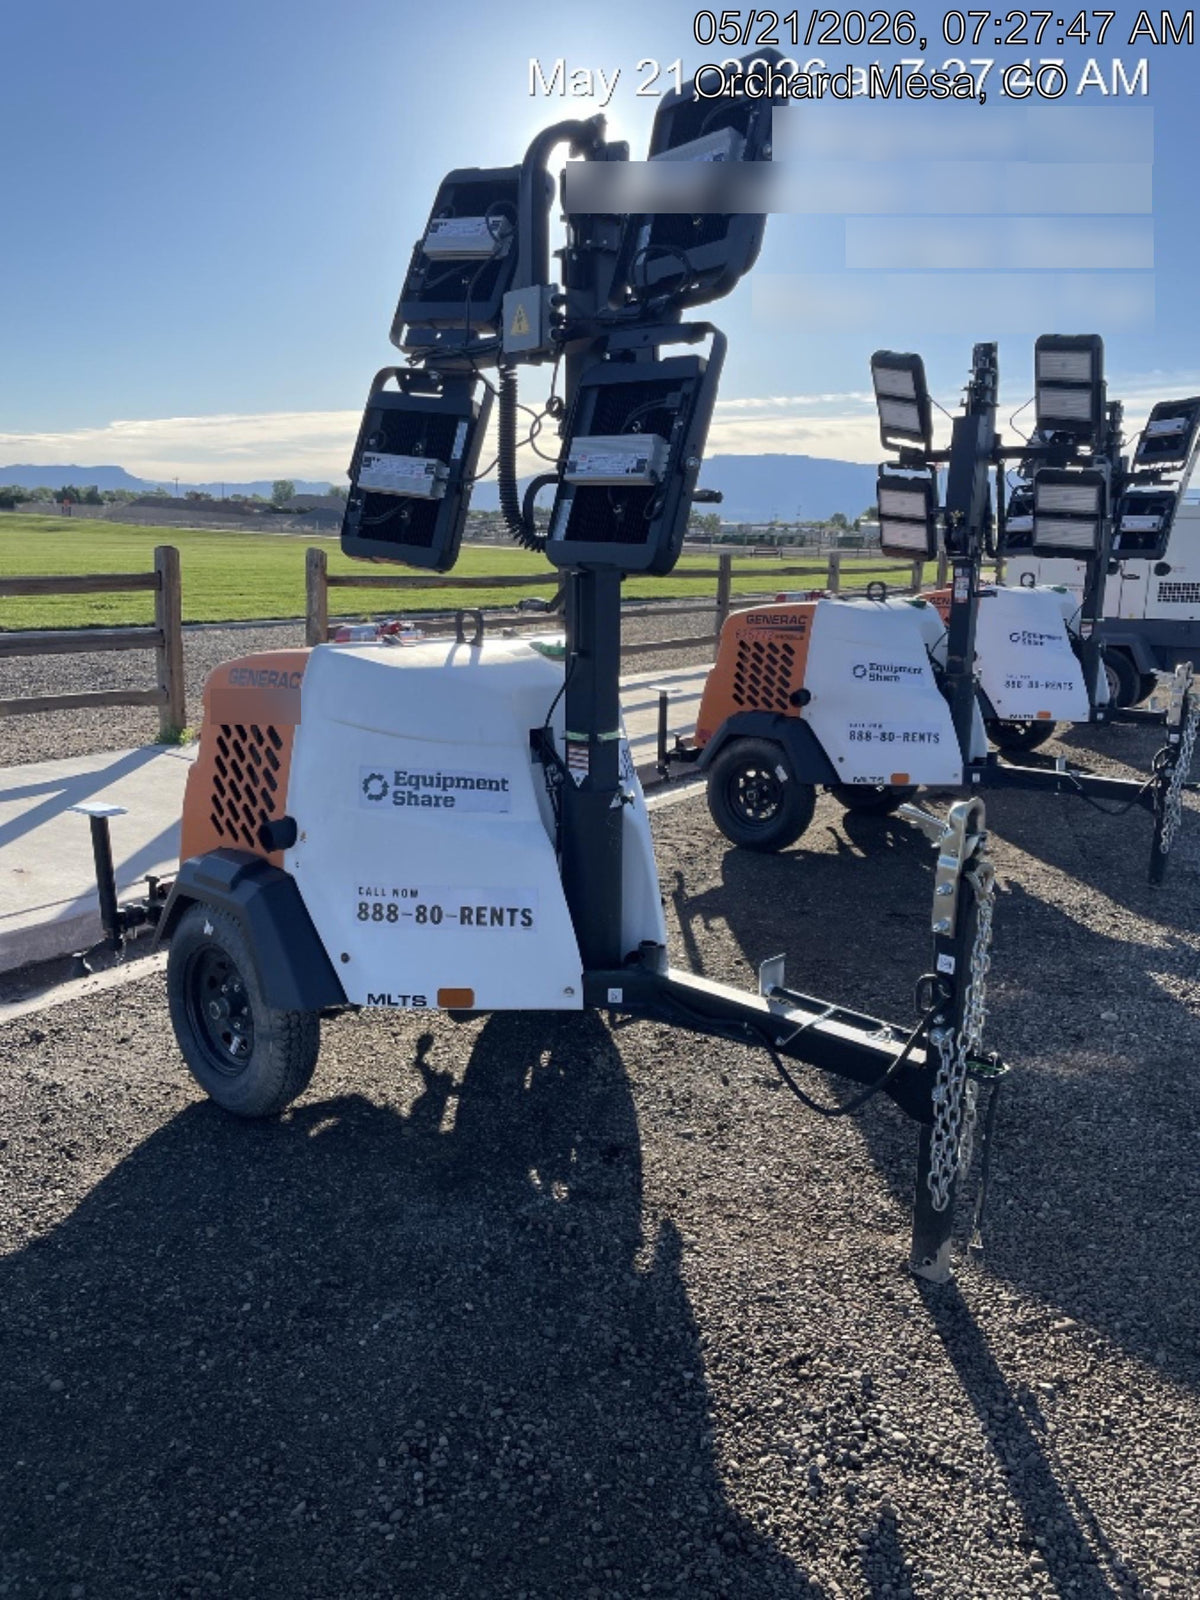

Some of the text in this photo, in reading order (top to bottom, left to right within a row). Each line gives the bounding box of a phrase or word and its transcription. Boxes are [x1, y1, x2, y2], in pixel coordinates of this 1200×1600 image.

[746, 614, 808, 625] GENERAC
[228, 667, 304, 690] GENERAC
[849, 730, 940, 744] 888-80-RENTS
[394, 770, 509, 792] Equipment
[392, 790, 456, 808] Share
[358, 886, 419, 899] CALL NOW
[357, 901, 533, 928] 888-80-RENTS
[367, 993, 428, 1007] MLTS
